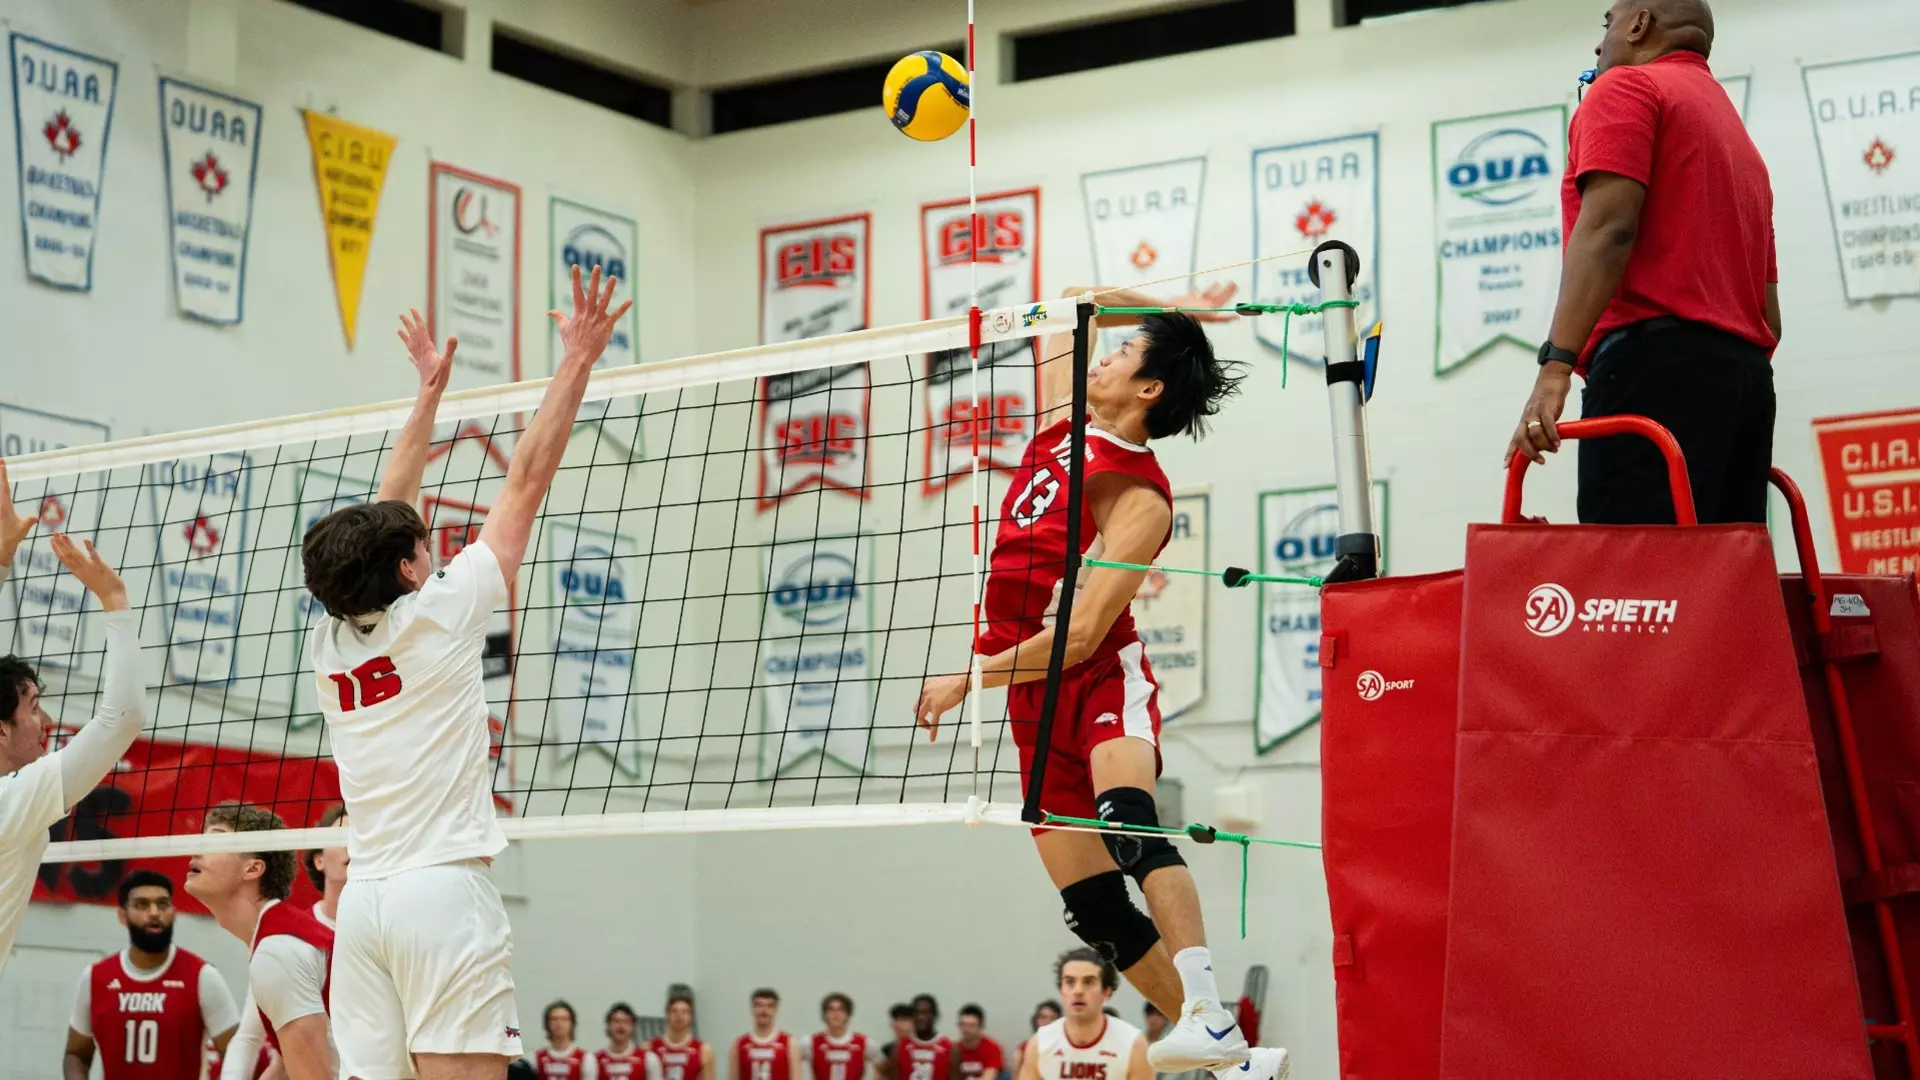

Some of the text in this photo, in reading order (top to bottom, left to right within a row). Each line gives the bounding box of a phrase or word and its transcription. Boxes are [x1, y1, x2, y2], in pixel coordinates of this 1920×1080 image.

[1447, 153, 1552, 187] OUA
[938, 211, 1023, 258] CIS
[1440, 227, 1561, 258] CHAMPIONS
[562, 243, 627, 283] OUA
[777, 236, 857, 281] CIS
[1841, 439, 1920, 472] C.I.A.
[1010, 467, 1061, 528] 13
[1843, 487, 1920, 519] U.S.I.
[1275, 536, 1336, 561] OU
[560, 569, 625, 600] OUA
[773, 577, 859, 605] OUA
[1578, 598, 1678, 623] SPIETH
[1583, 624, 1669, 634] AMERICA
[328, 656, 402, 712] 16
[1385, 679, 1415, 691] SPORT
[118, 991, 167, 1013] YORK
[125, 1019, 158, 1064] 10
[1060, 1061, 1107, 1080] LIONS
